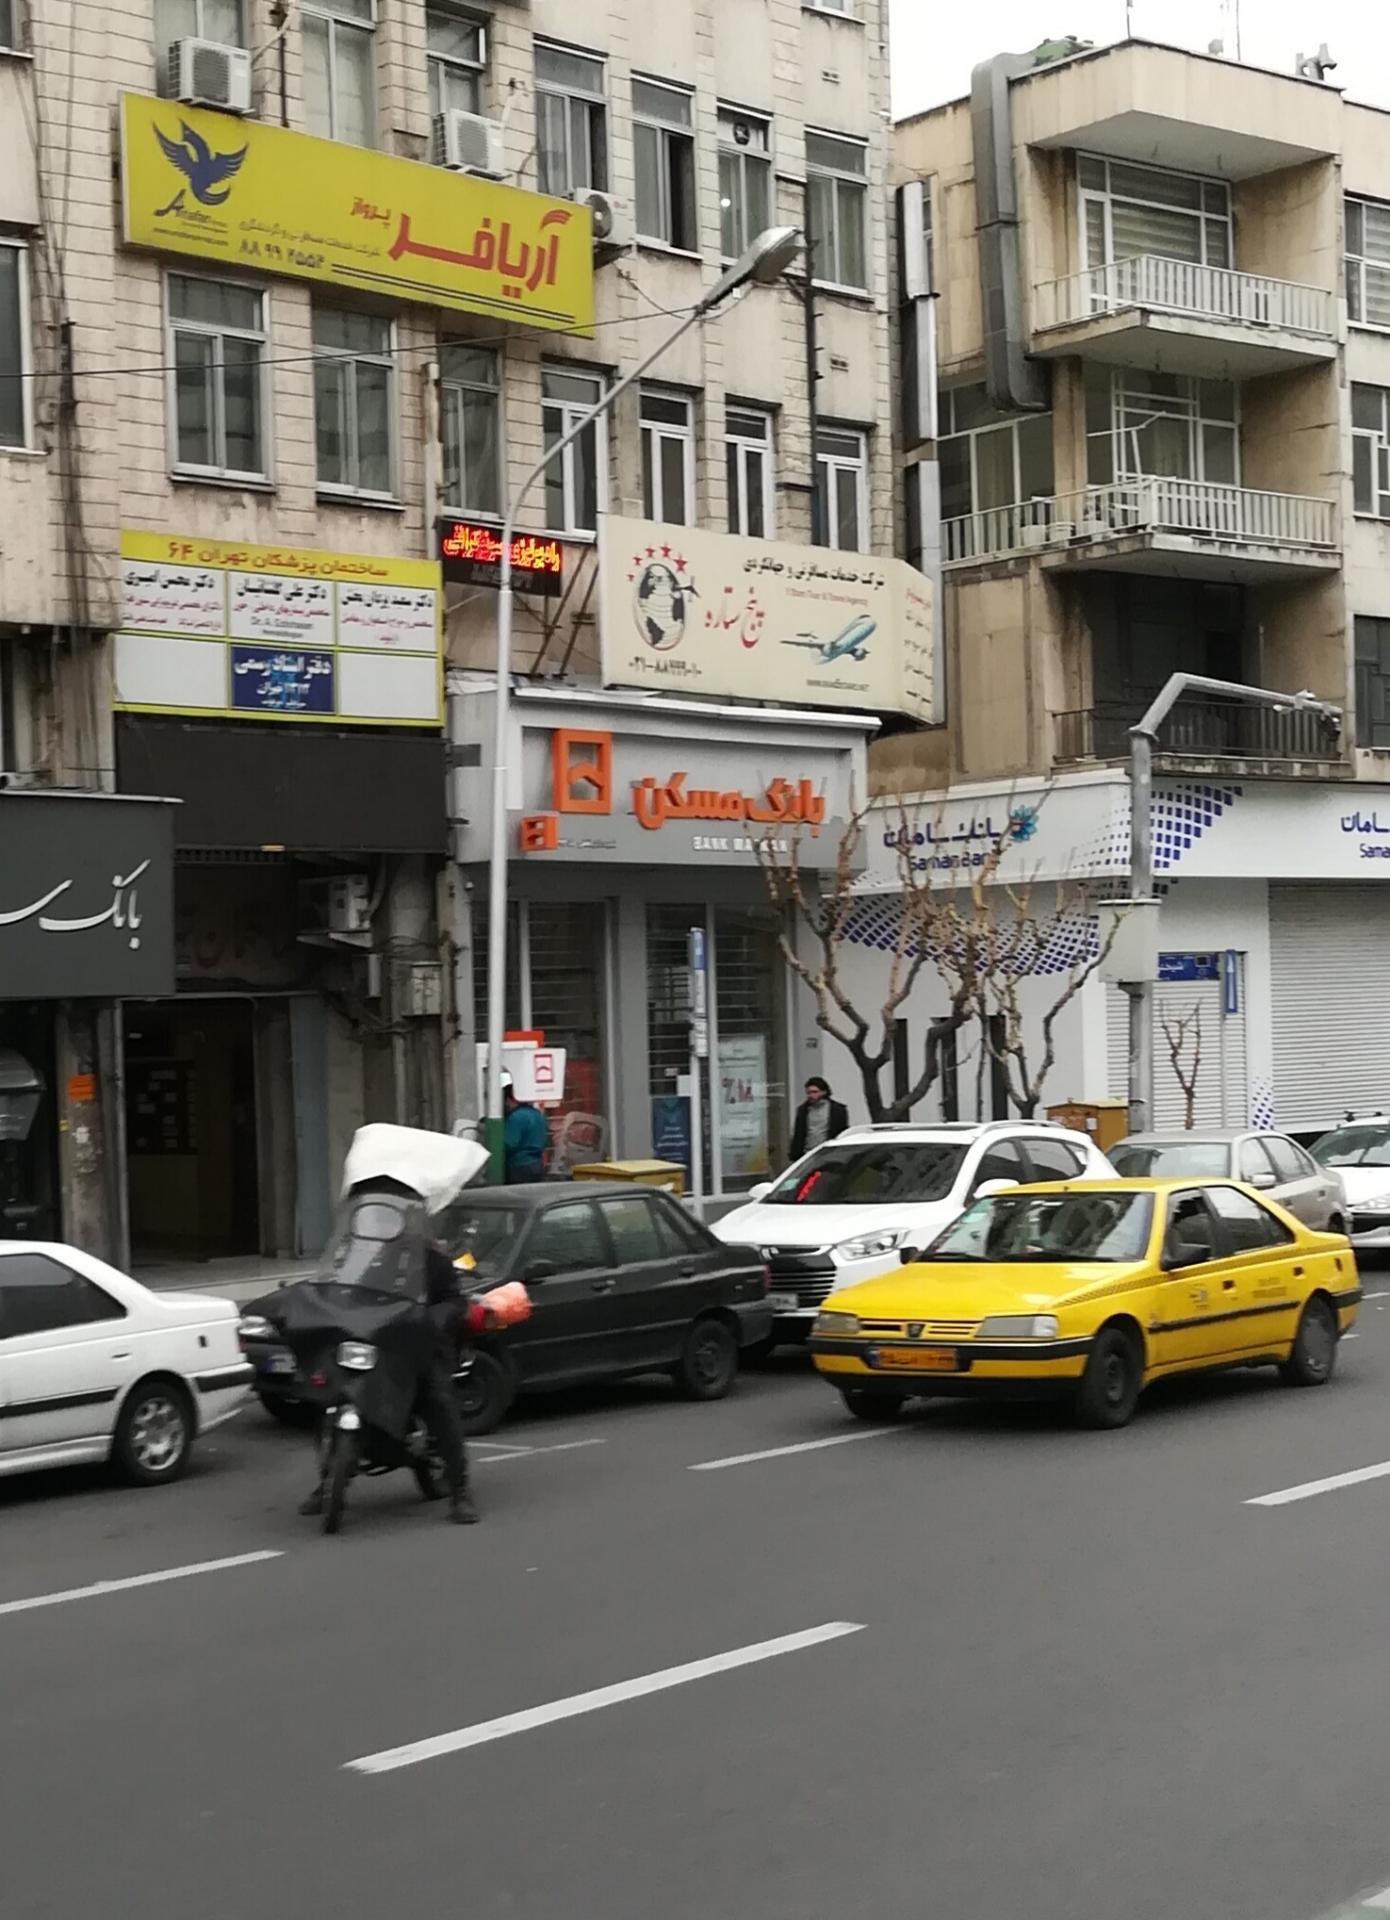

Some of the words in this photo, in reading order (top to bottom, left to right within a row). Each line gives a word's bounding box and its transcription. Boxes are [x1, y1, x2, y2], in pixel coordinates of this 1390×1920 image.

[388, 209, 572, 299] آریافر
[199, 548, 248, 566] تهران
[253, 553, 317, 576] پزشکان
[321, 559, 388, 577] ساختمان
[632, 772, 743, 831] مسکن
[743, 778, 825, 838] بانک
[951, 817, 1001, 845] بانک
[38, 859, 151, 950] بانک
